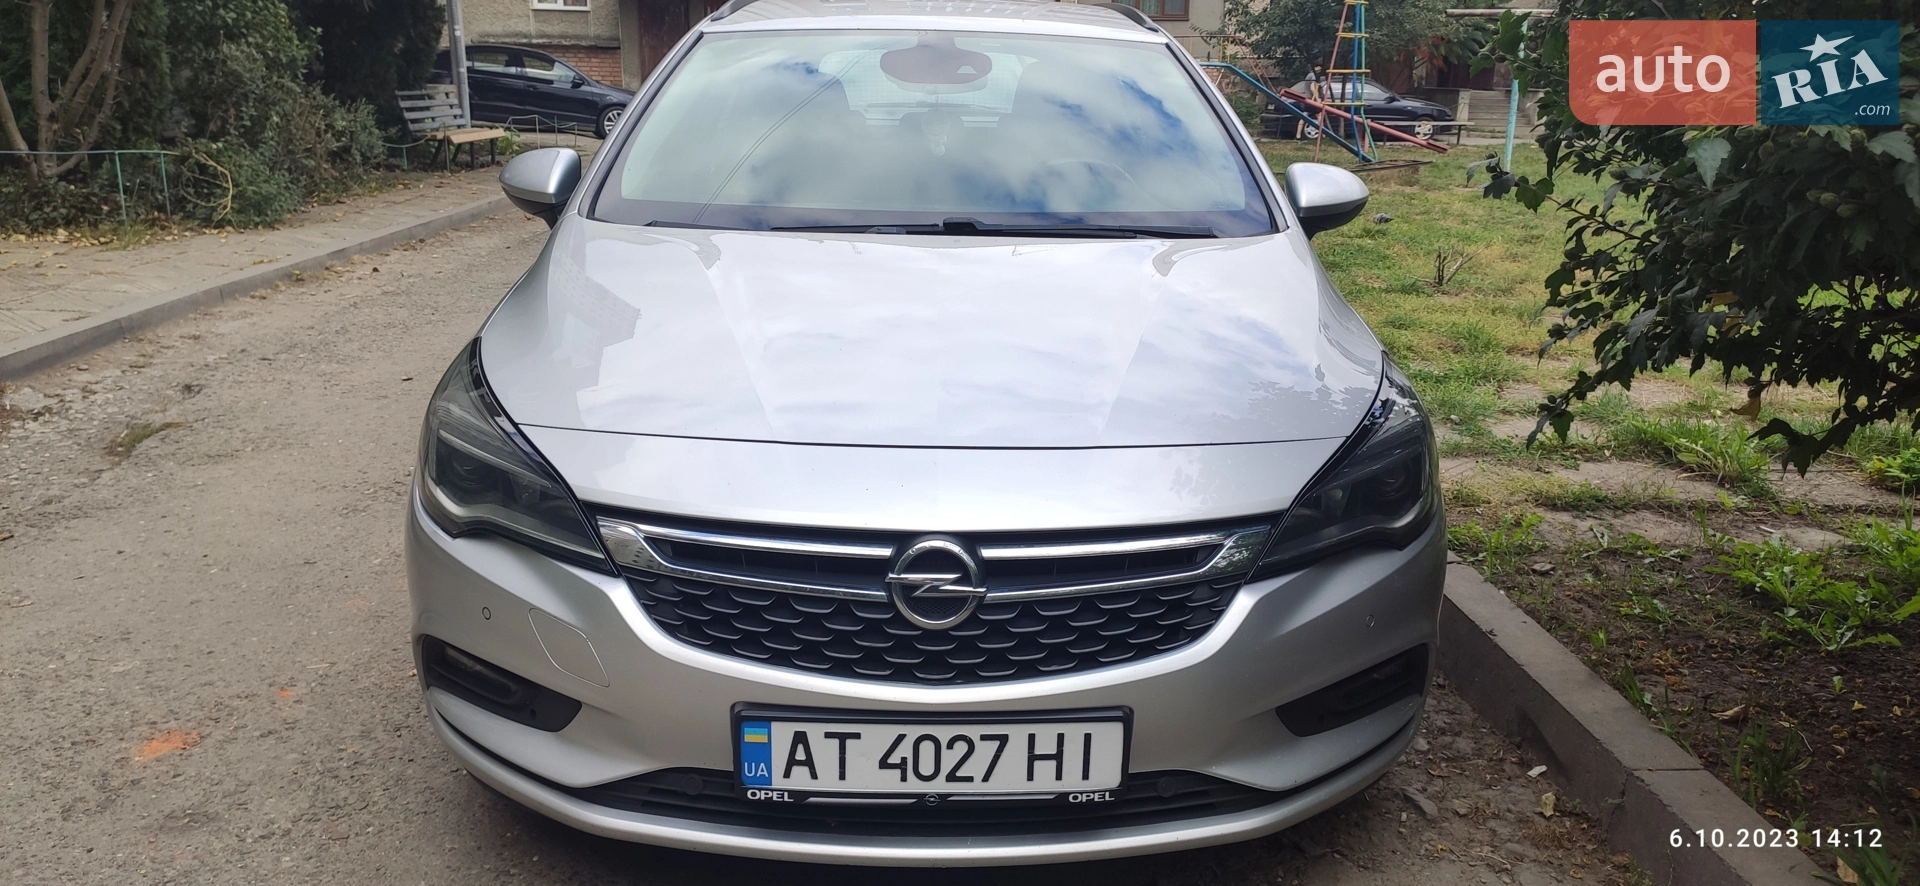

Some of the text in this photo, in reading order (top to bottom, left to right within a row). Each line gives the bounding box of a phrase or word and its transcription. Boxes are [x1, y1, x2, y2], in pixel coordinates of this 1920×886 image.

[783, 730, 1092, 783] AT 4027 HI
[744, 762, 769, 778] UA
[746, 789, 794, 802] OPEL
[1068, 791, 1115, 803] OPEL
